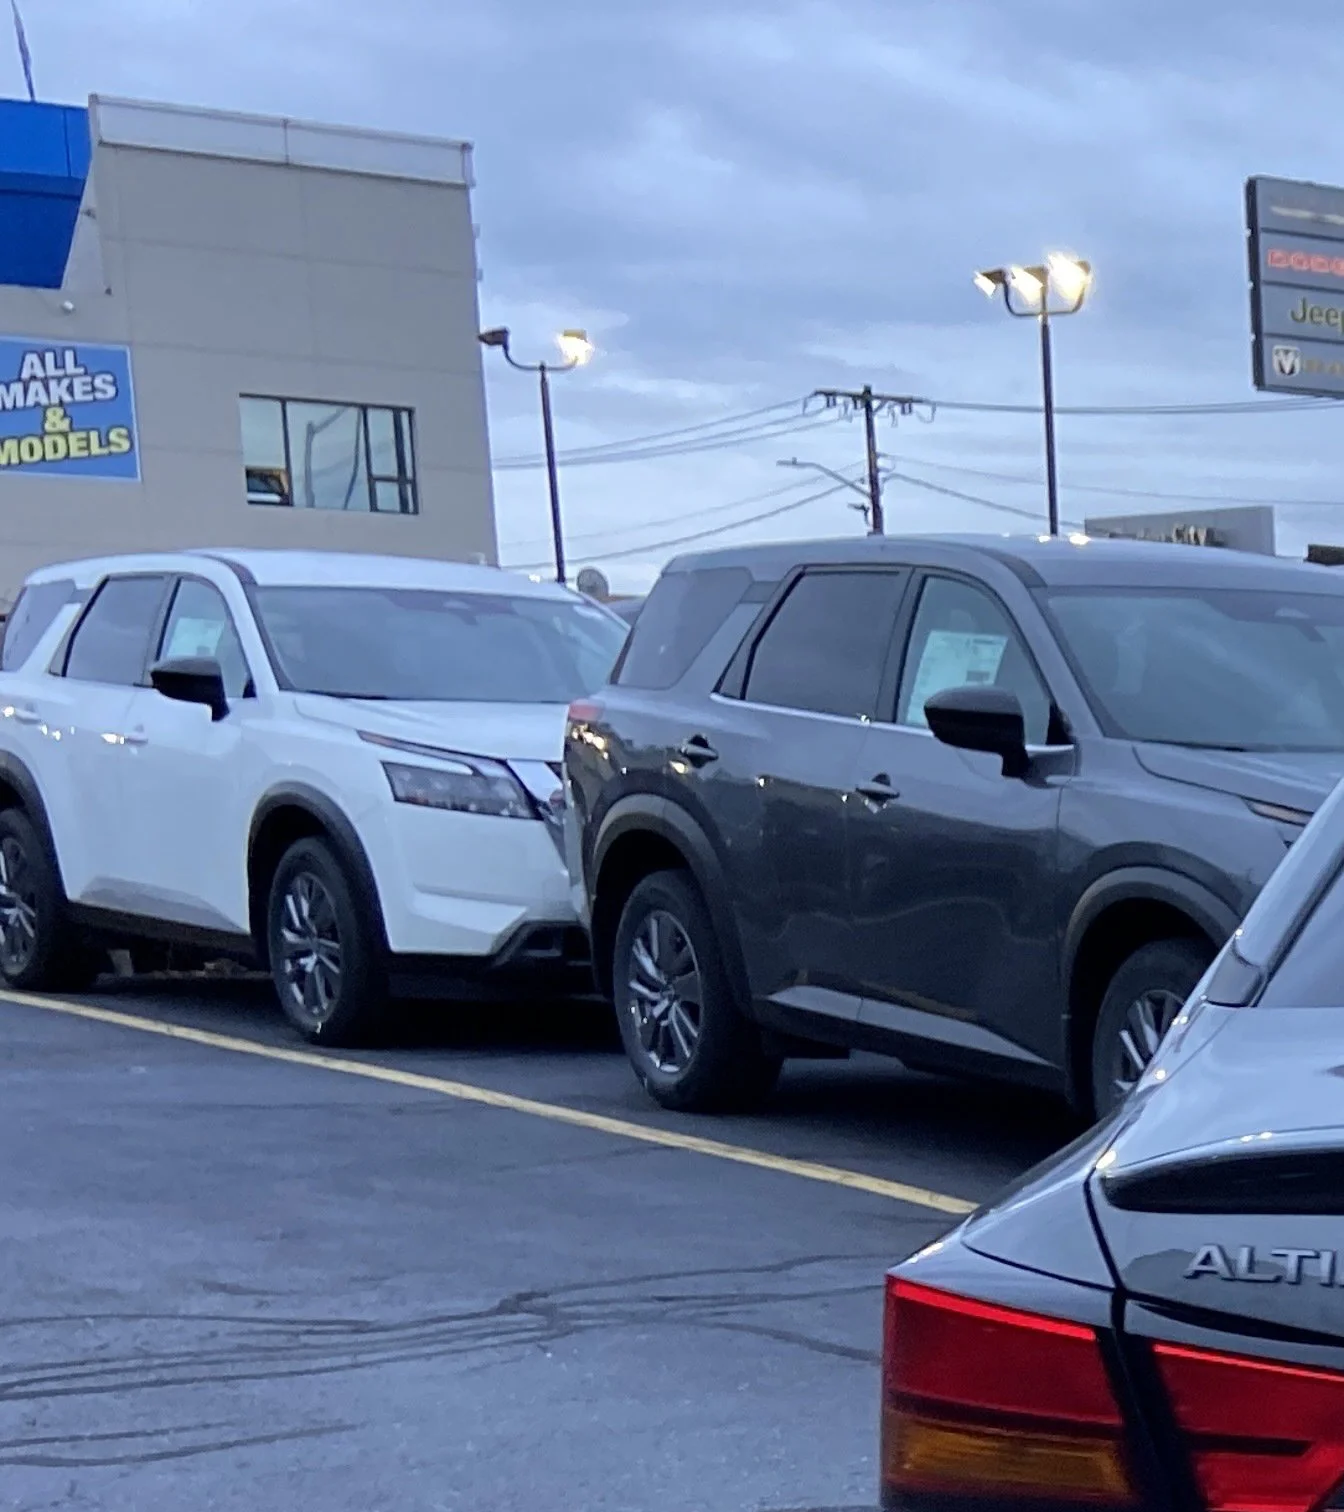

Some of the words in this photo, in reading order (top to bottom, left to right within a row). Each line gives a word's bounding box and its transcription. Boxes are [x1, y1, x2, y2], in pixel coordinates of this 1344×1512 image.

[20, 348, 86, 380] ALL
[0, 372, 118, 411] MAKES
[44, 406, 71, 433] &
[0, 426, 131, 466] MODELS
